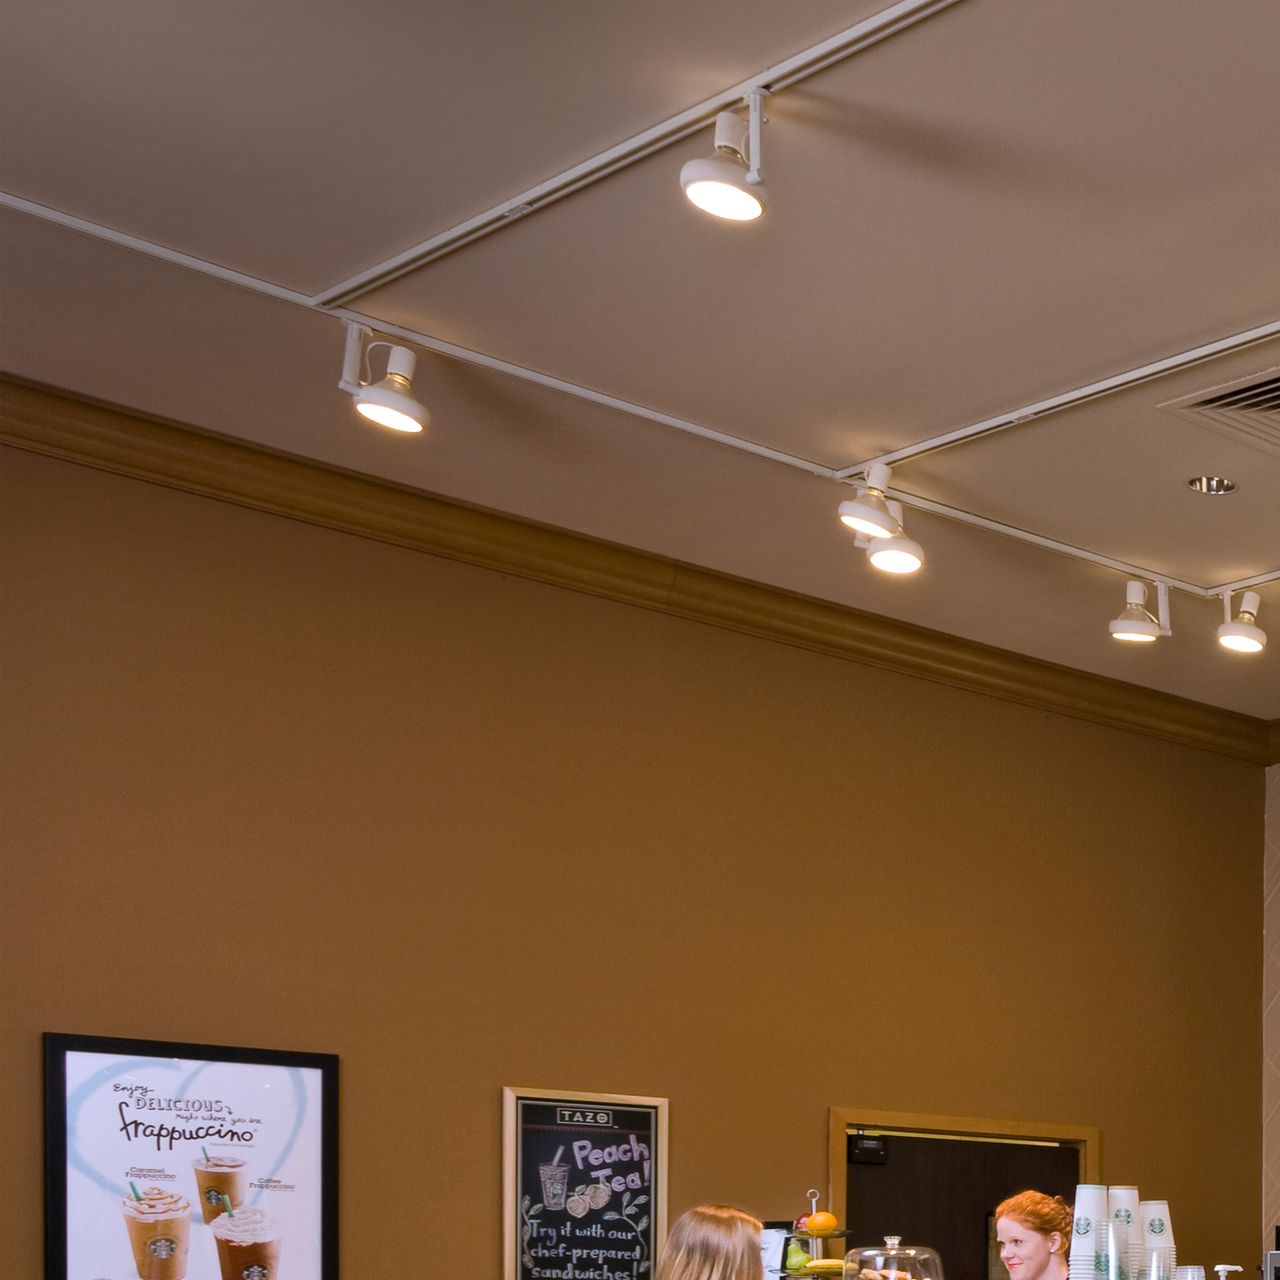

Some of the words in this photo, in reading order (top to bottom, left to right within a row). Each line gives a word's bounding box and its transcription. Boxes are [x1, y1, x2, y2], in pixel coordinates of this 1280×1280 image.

[113, 1083, 154, 1098] Enjoy
[135, 1097, 224, 1113] DELICIOUS
[118, 1101, 254, 1151] frappuccino
[562, 1111, 609, 1124] TAZO
[572, 1134, 650, 1170] Peach
[125, 1171, 177, 1180] Frappuccino
[130, 1166, 166, 1174] Caramel
[590, 1159, 651, 1192] Tea!
[249, 1182, 296, 1191] Frappuccino
[529, 1219, 557, 1246] Try
[560, 1221, 572, 1237] it
[575, 1223, 605, 1238] with
[608, 1229, 636, 1240] our
[530, 1243, 641, 1264] chef-prepared
[531, 1261, 638, 1280] sandwiches!
